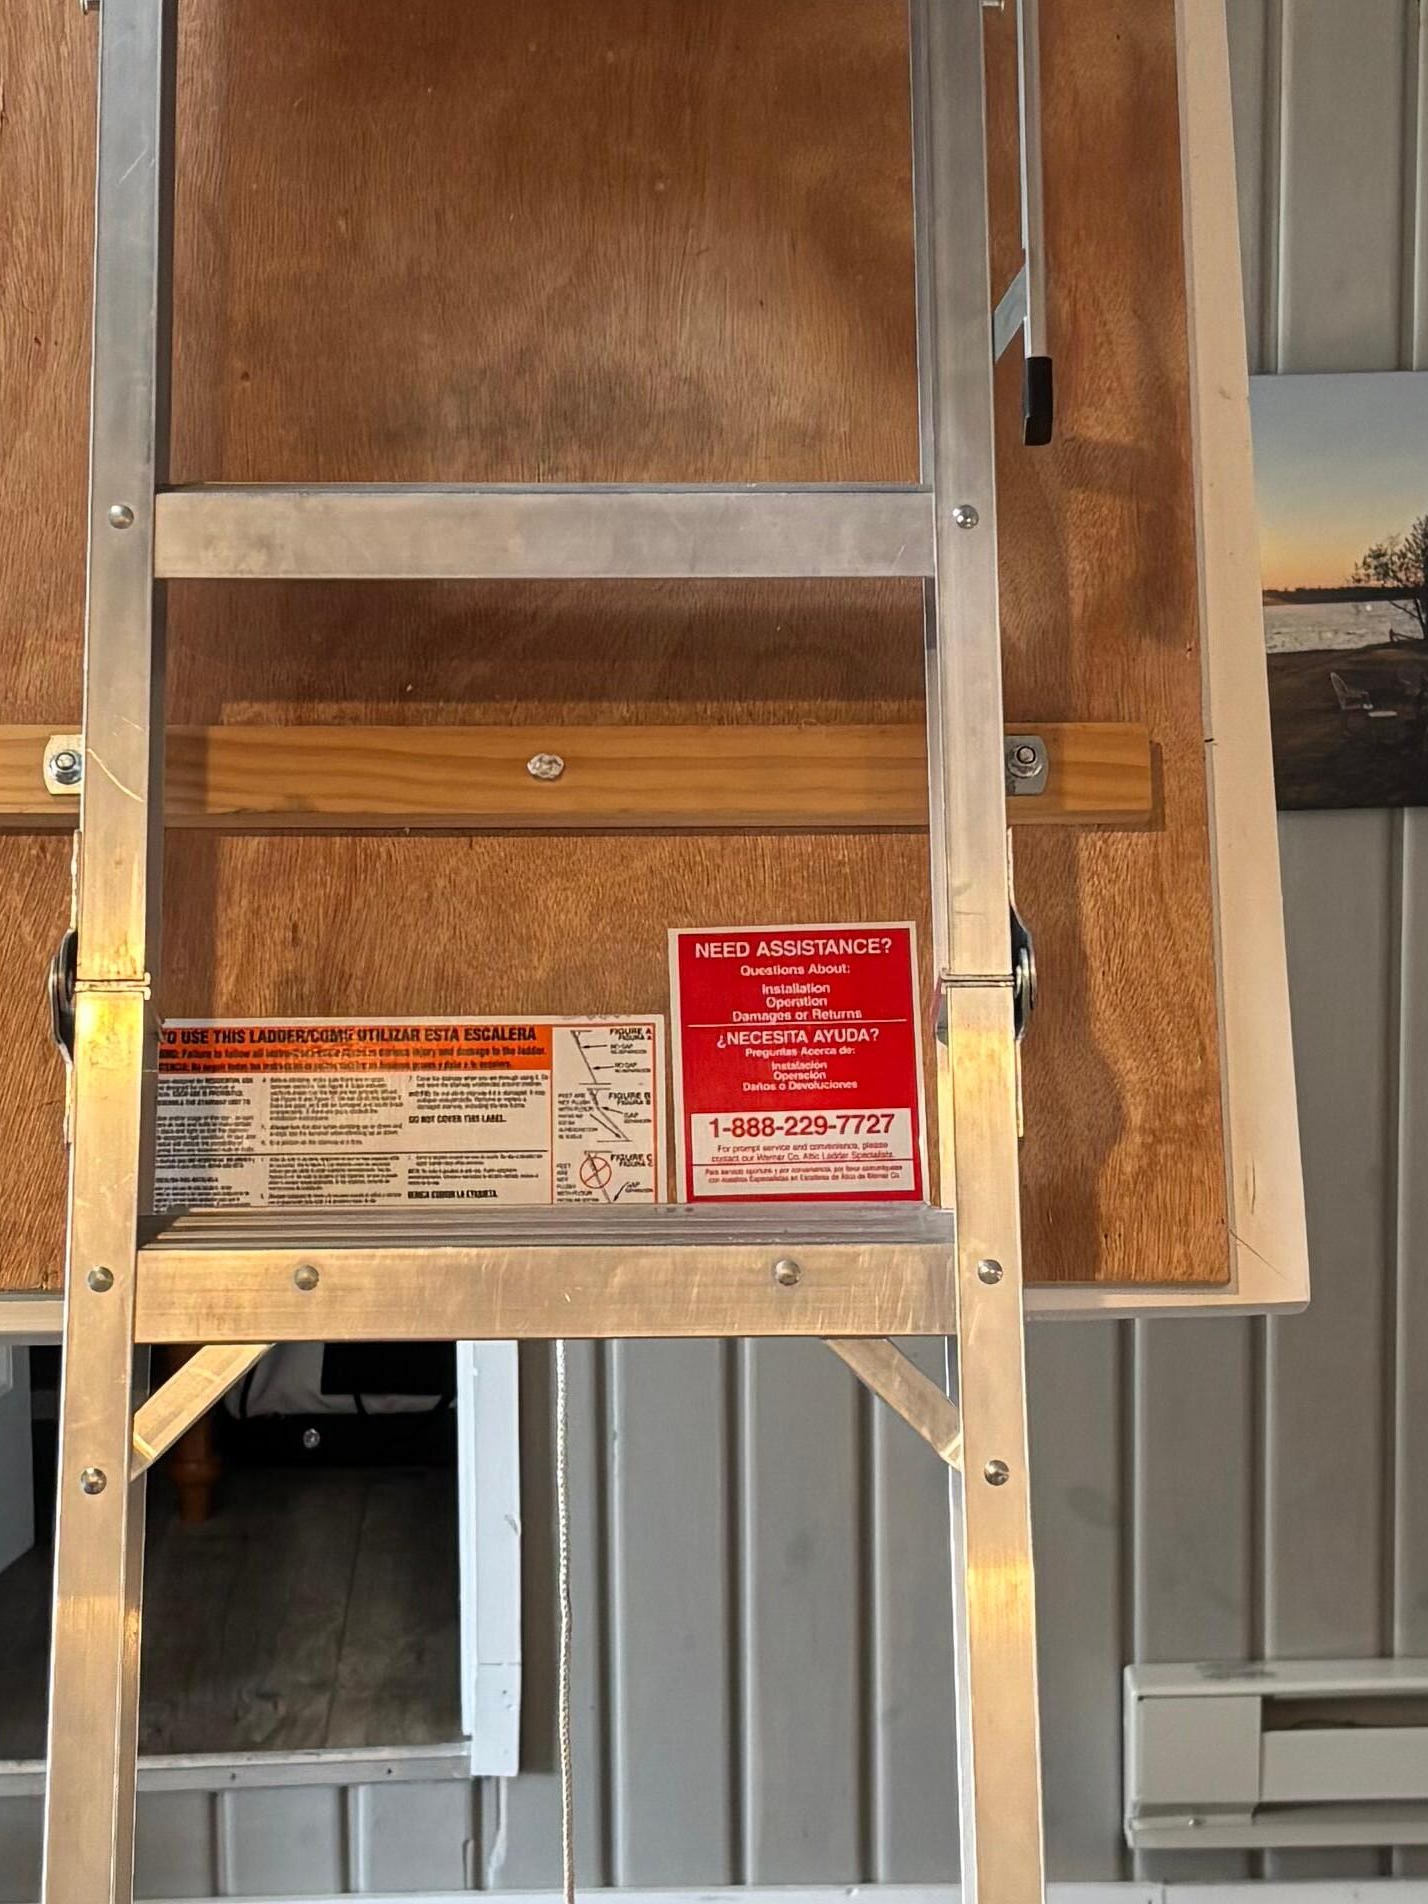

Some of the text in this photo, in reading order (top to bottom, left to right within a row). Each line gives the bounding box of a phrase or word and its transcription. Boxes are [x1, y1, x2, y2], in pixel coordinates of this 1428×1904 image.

[695, 938, 893, 958] NEED ASSISTANCE?
[740, 963, 851, 977] Questions About:
[762, 983, 831, 995] Installation
[766, 996, 828, 1009] Operation
[733, 1008, 863, 1024] Damages or Returns
[181, 1029, 209, 1044] USE
[213, 1029, 245, 1044] THIS
[357, 1027, 420, 1042] UTILIZAR
[424, 1027, 460, 1041] ESTA
[464, 1026, 537, 1041] ESCALERA
[716, 1028, 880, 1048] ¿NECESITA AYUDA?
[745, 1048, 797, 1058] Preguntas
[800, 1046, 836, 1056] Acerca
[771, 1060, 828, 1071] Instalación
[773, 1070, 827, 1082] Operación
[779, 1082, 786, 1091] o
[788, 1079, 858, 1091] Devoluciones
[709, 1113, 896, 1138] 1-888-229-7727
